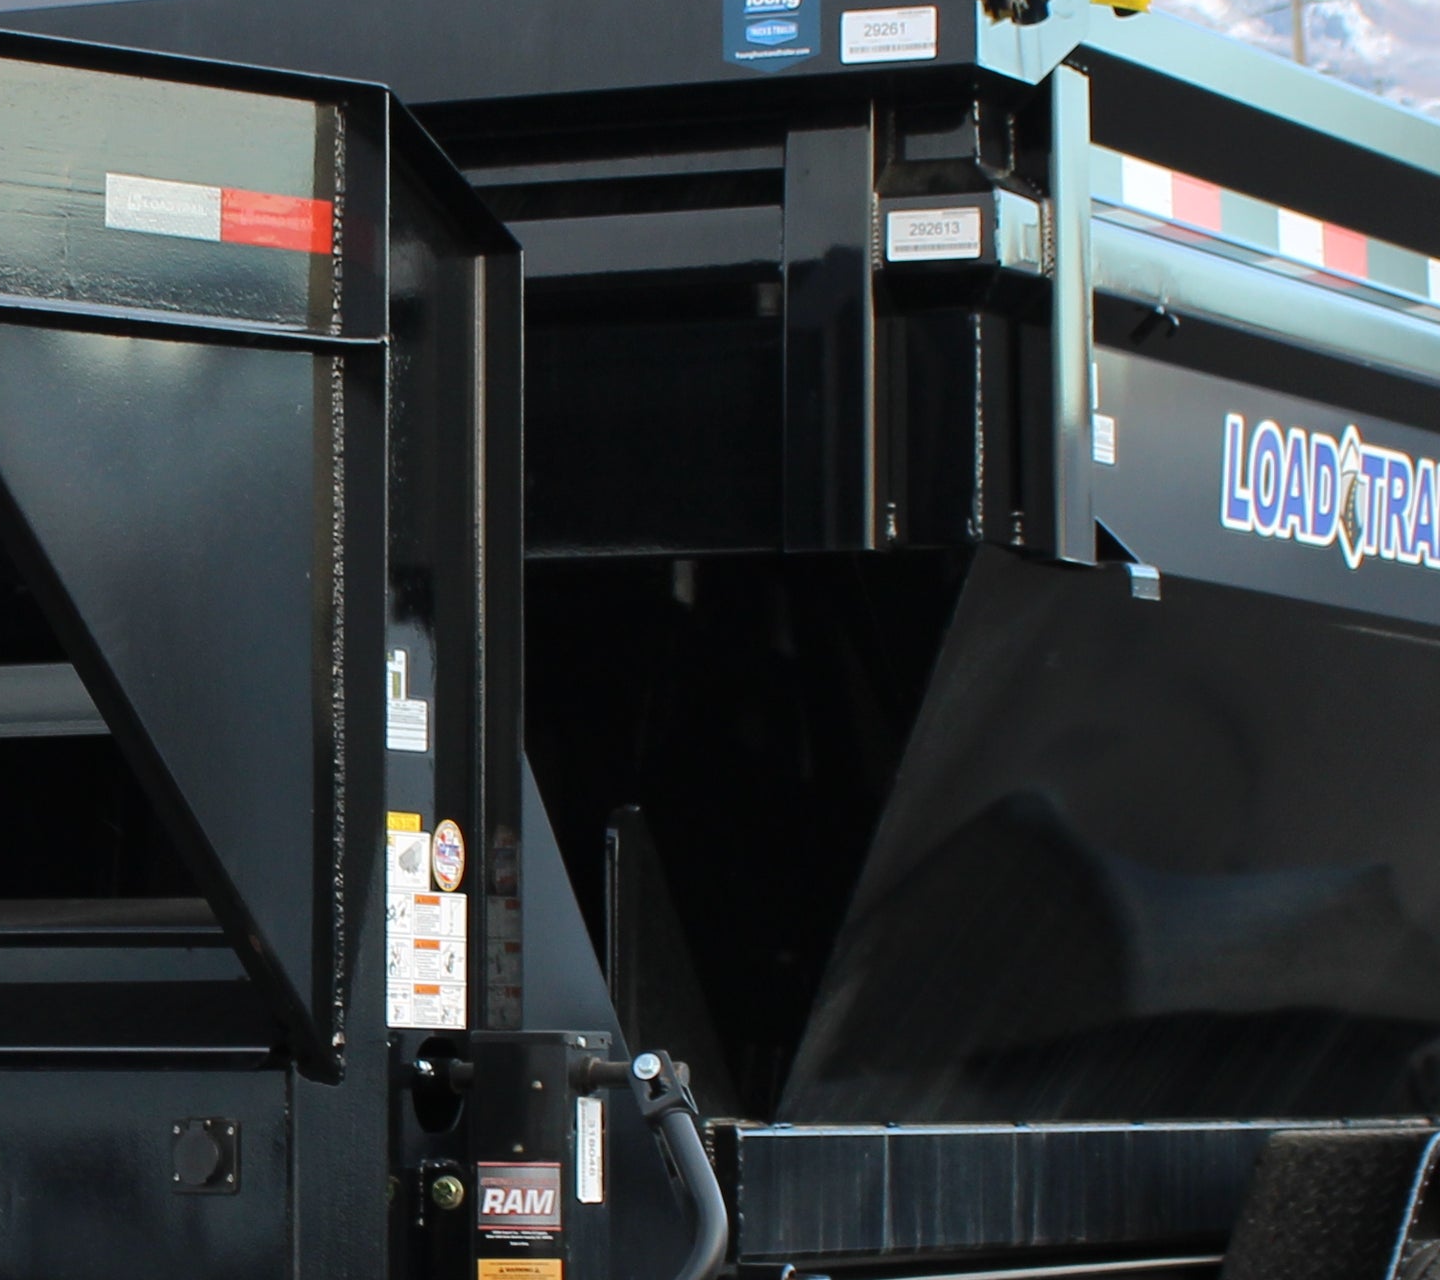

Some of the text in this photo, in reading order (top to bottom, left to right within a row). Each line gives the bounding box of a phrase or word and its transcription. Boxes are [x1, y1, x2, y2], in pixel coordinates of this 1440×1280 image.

[909, 221, 960, 236] 292613
[1221, 412, 1341, 547] LOAD
[482, 1187, 555, 1215] RAM
